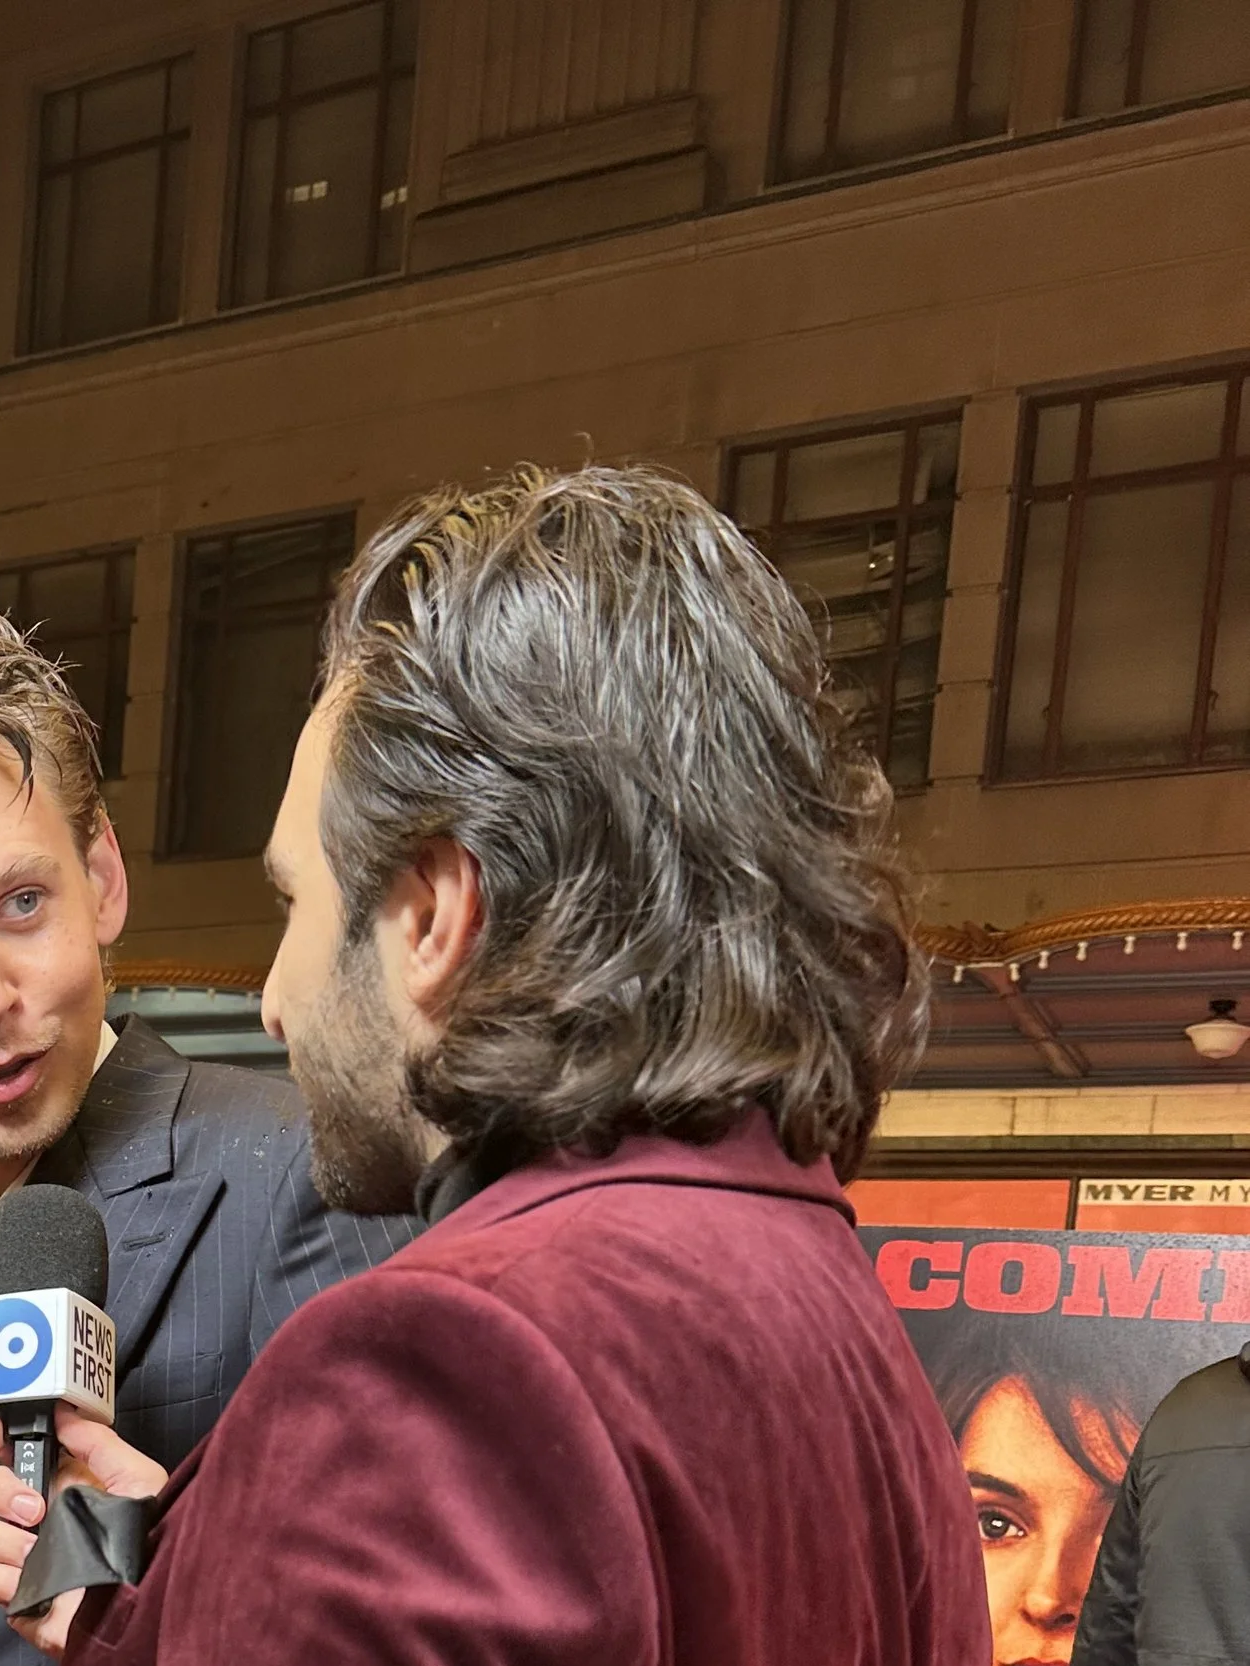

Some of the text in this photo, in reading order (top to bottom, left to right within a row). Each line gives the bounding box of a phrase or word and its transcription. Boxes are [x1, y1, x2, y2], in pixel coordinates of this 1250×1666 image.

[1084, 1184, 1196, 1202] MYER
[73, 1306, 112, 1366] NEWS
[73, 1347, 112, 1404] FIRST
